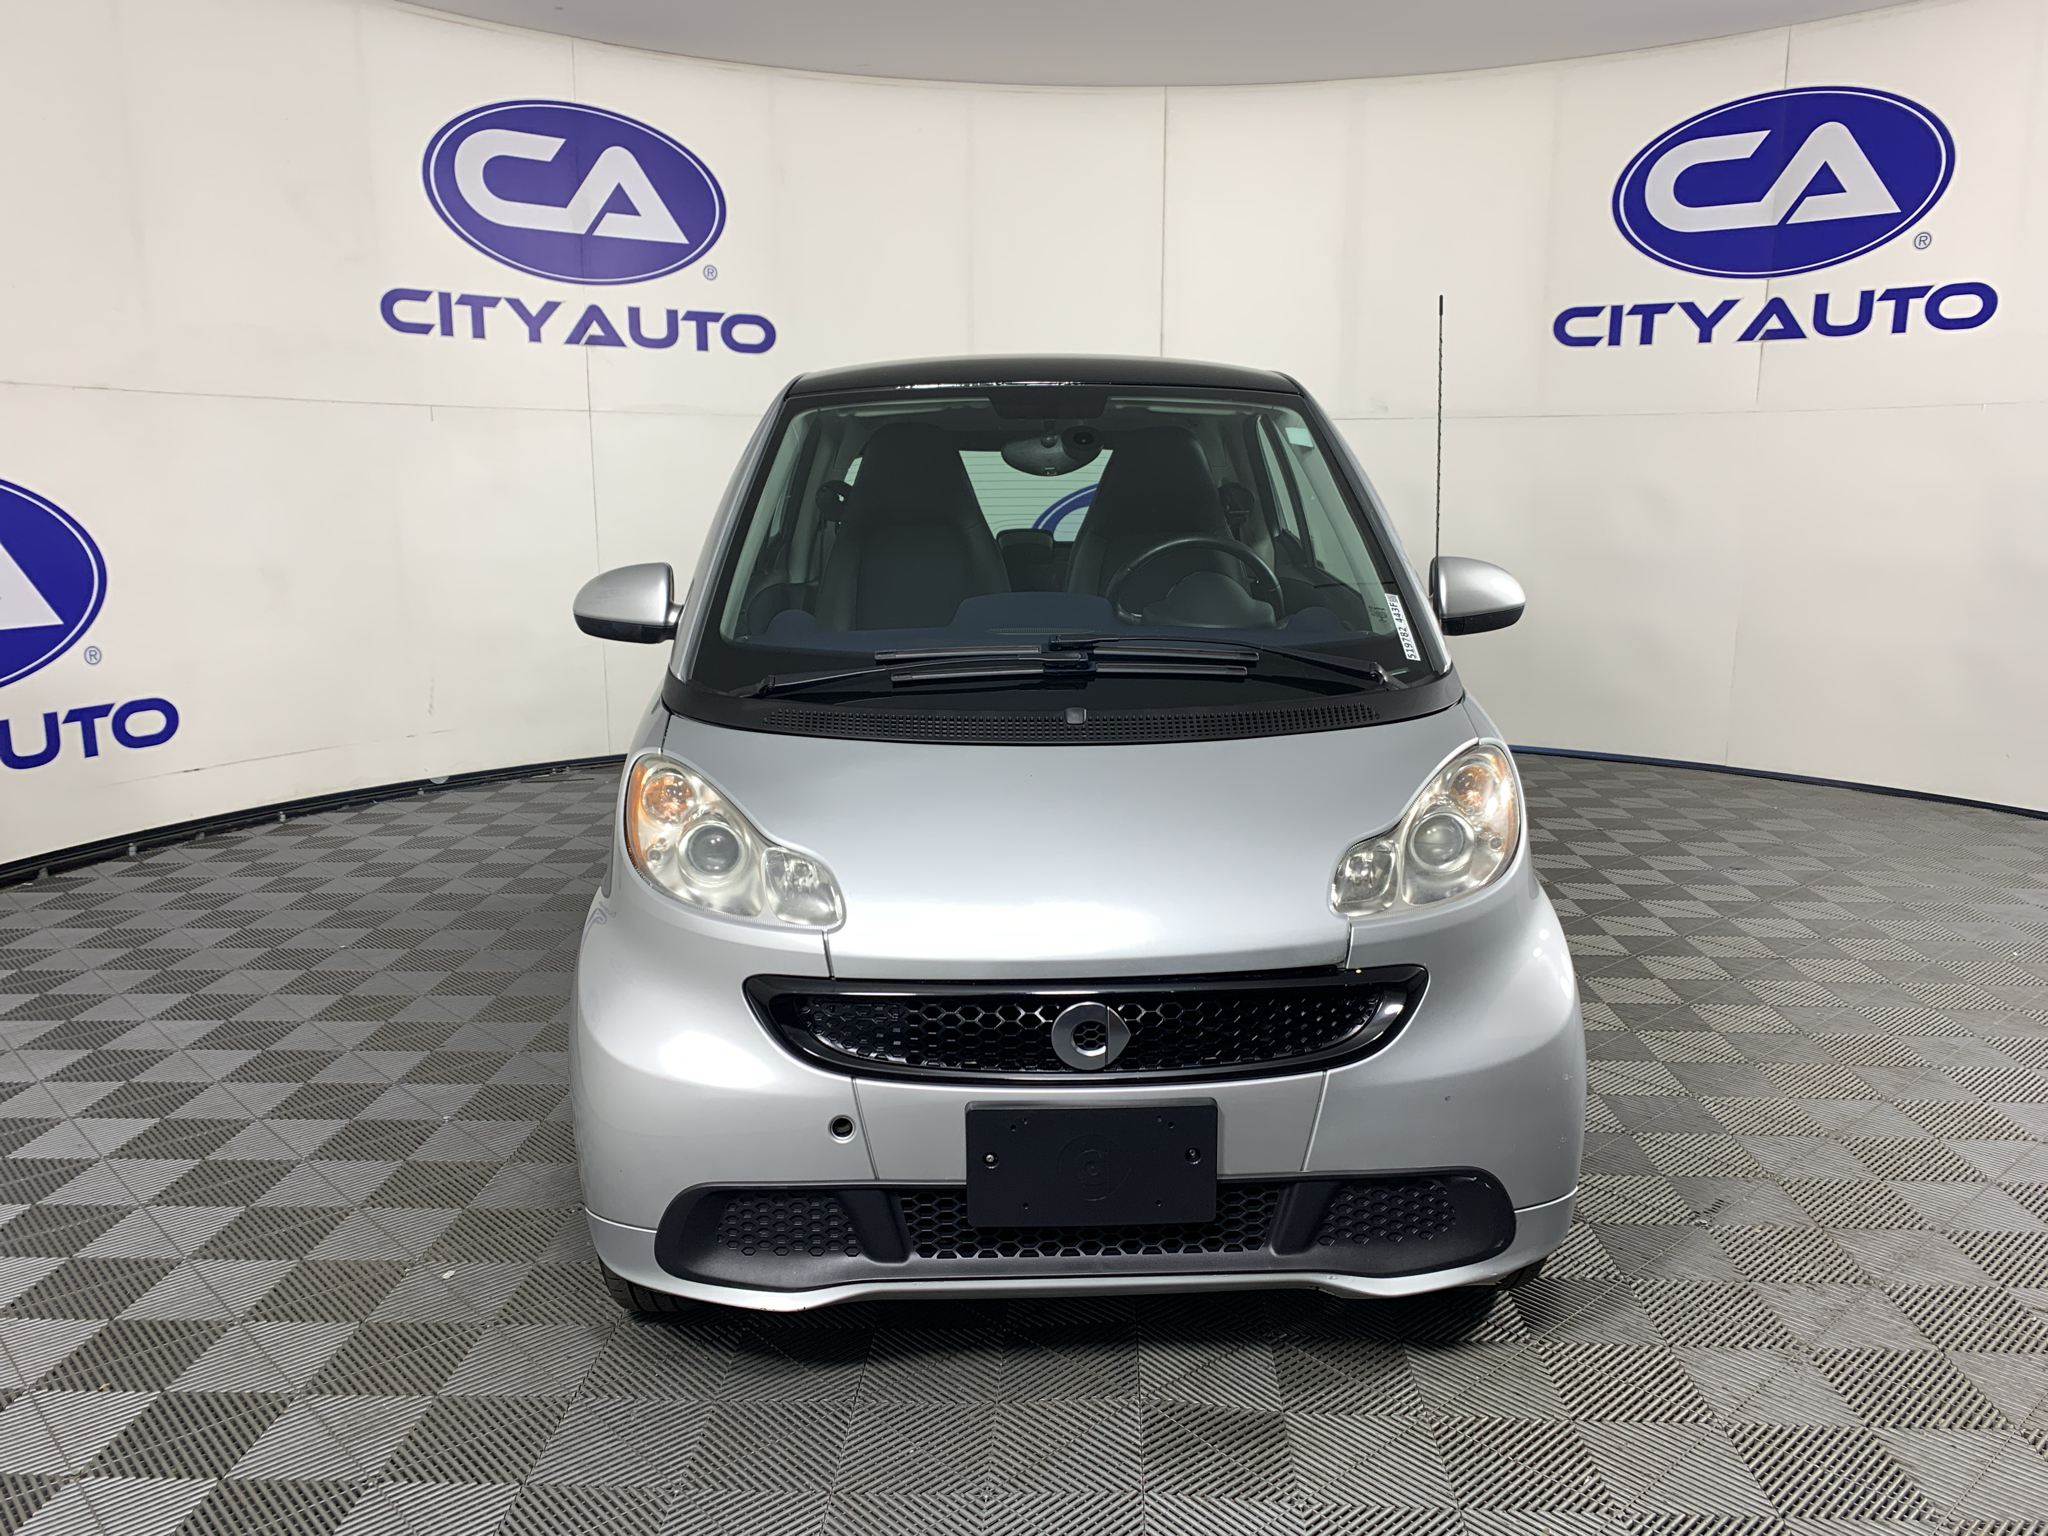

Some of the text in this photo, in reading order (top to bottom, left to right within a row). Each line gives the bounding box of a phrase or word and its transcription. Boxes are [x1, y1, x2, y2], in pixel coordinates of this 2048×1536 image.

[454, 129, 690, 244] CA
[1645, 121, 1901, 232] CA
[380, 288, 776, 354] CITY AUTO
[1553, 282, 1998, 347] CITY AUTO
